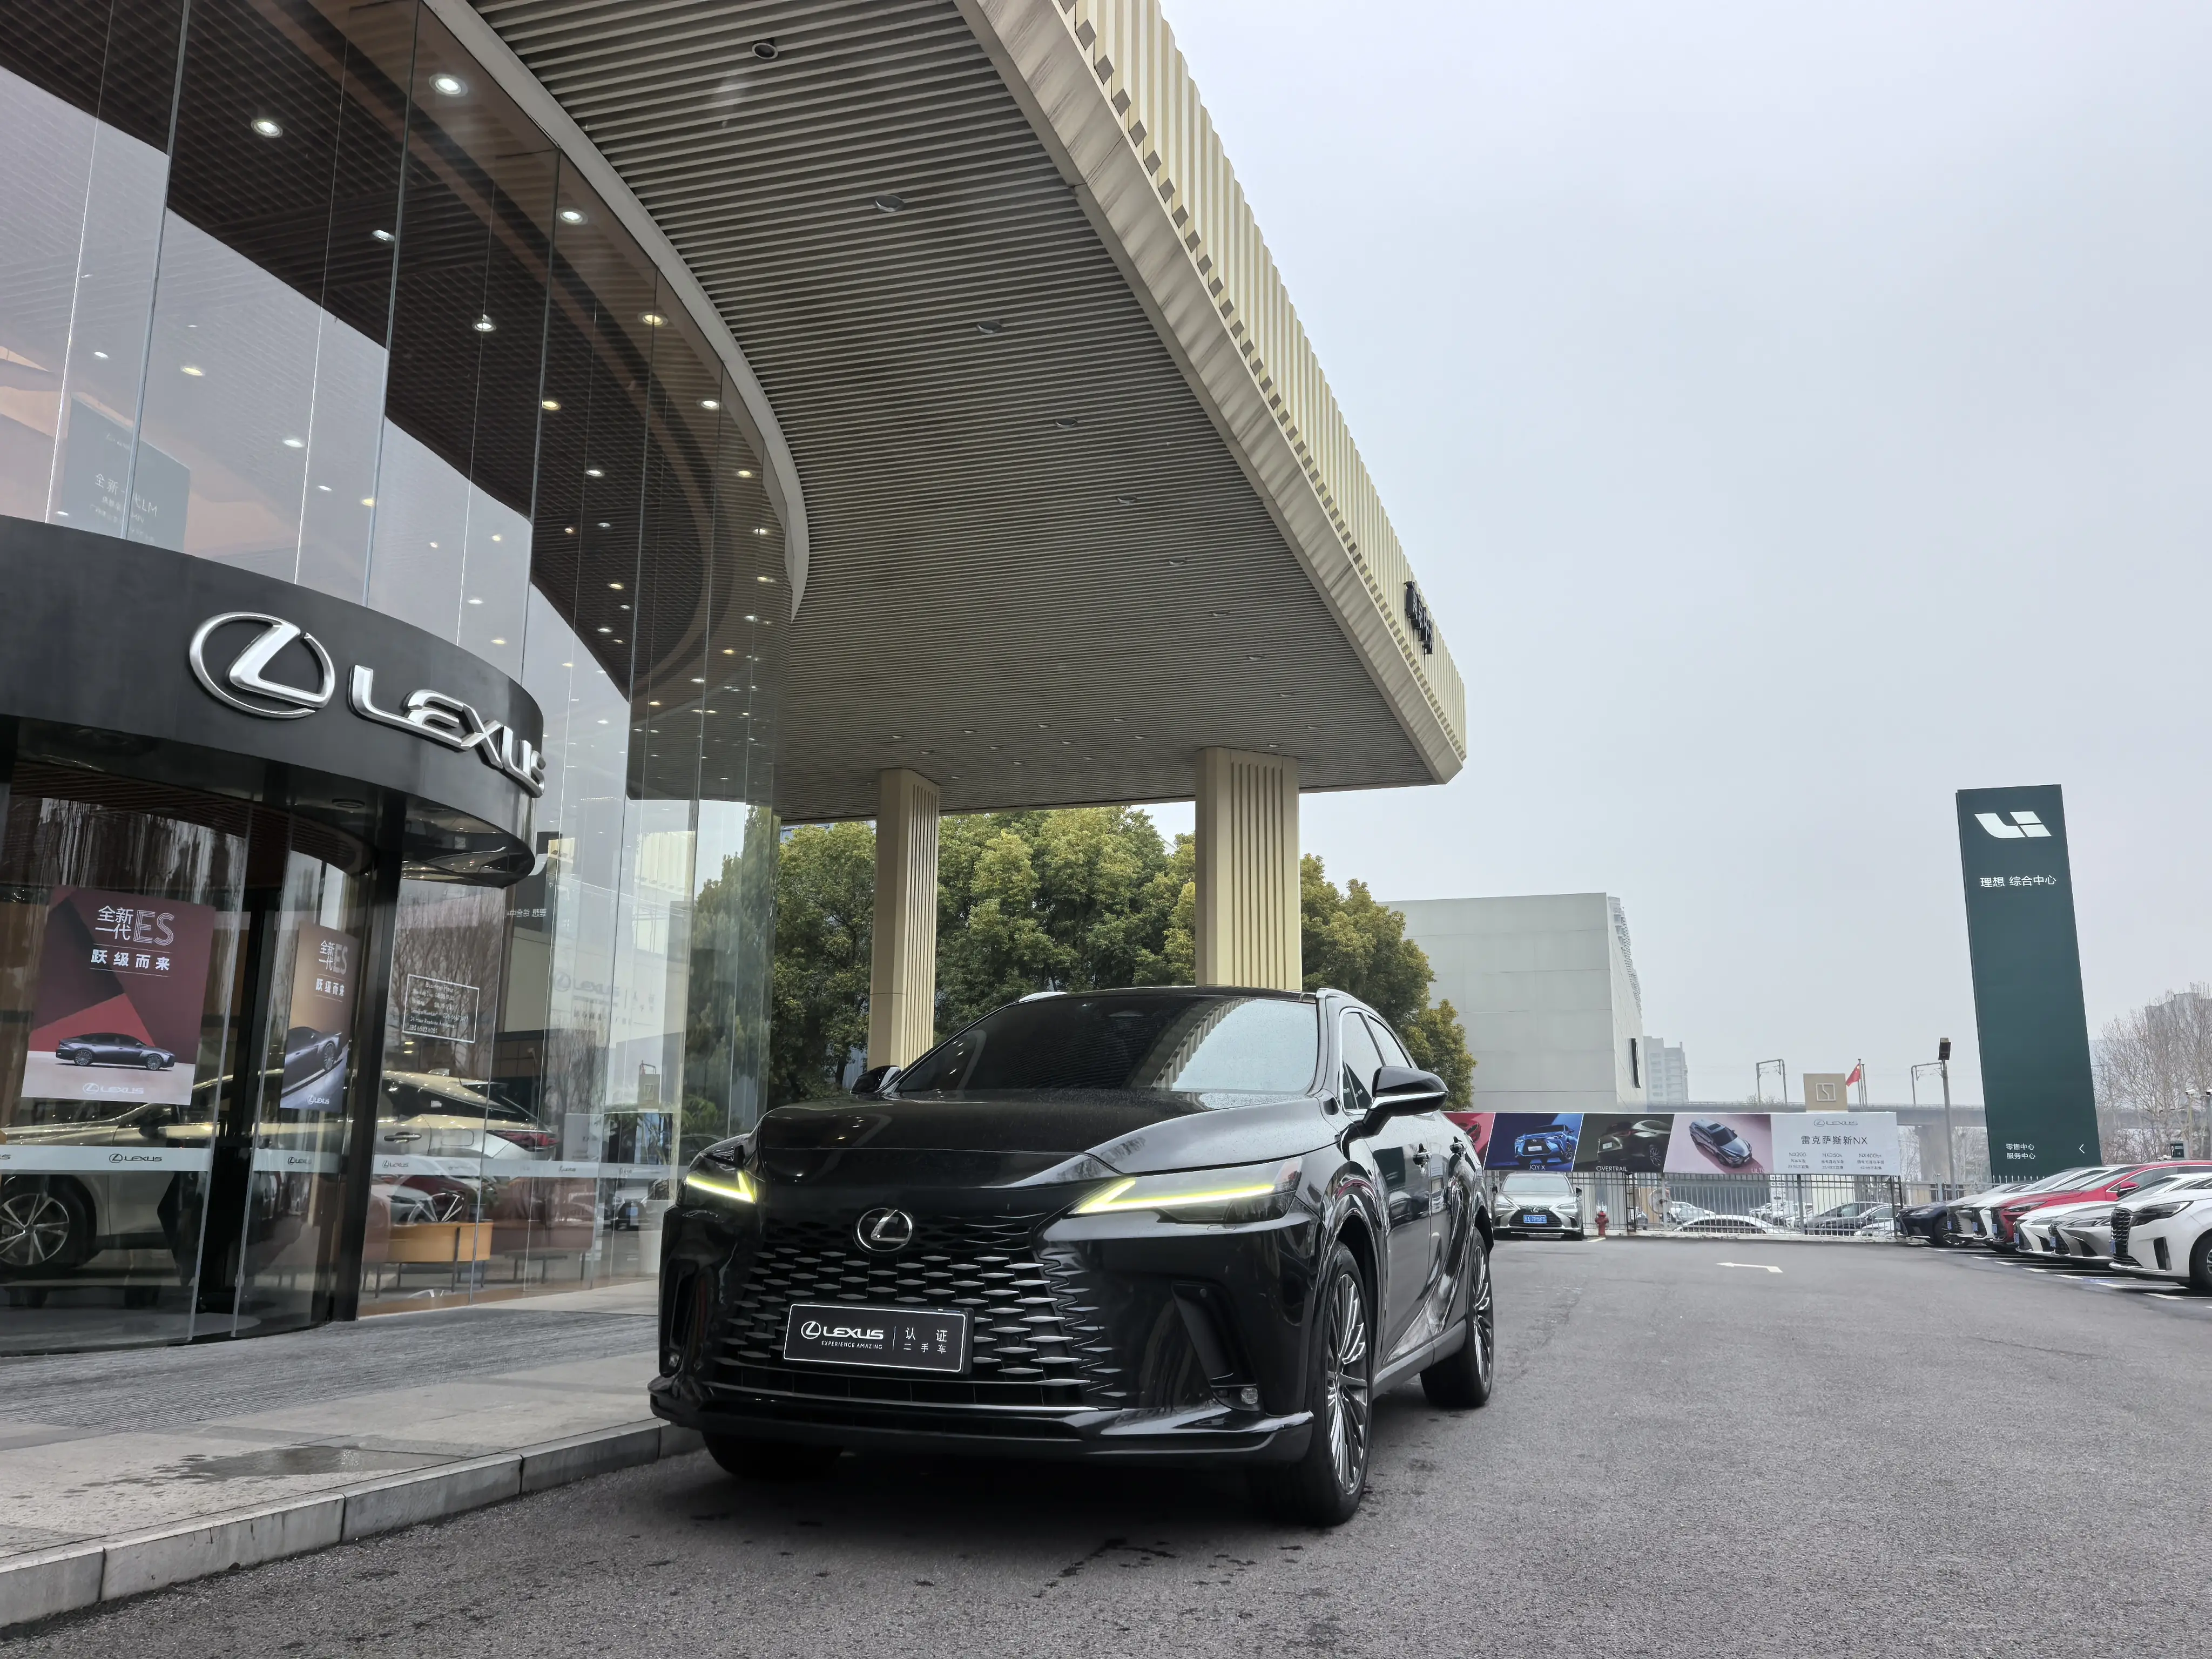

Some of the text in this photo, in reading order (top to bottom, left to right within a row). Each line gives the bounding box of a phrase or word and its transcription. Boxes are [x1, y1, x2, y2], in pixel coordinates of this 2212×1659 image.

[349, 665, 546, 799] LEXUS
[1980, 875, 2056, 887] 理想 综合中心
[97, 905, 134, 924] 全新
[95, 923, 131, 941] 一代
[133, 909, 174, 946] ES
[90, 949, 170, 970] 跃级而来
[333, 943, 348, 975] ES
[1801, 1136, 1868, 1145] 雷克萨斯新NX
[822, 1326, 884, 1340] LEXUS
[905, 1327, 948, 1343] 认证
[903, 1343, 947, 1354] 二手车
